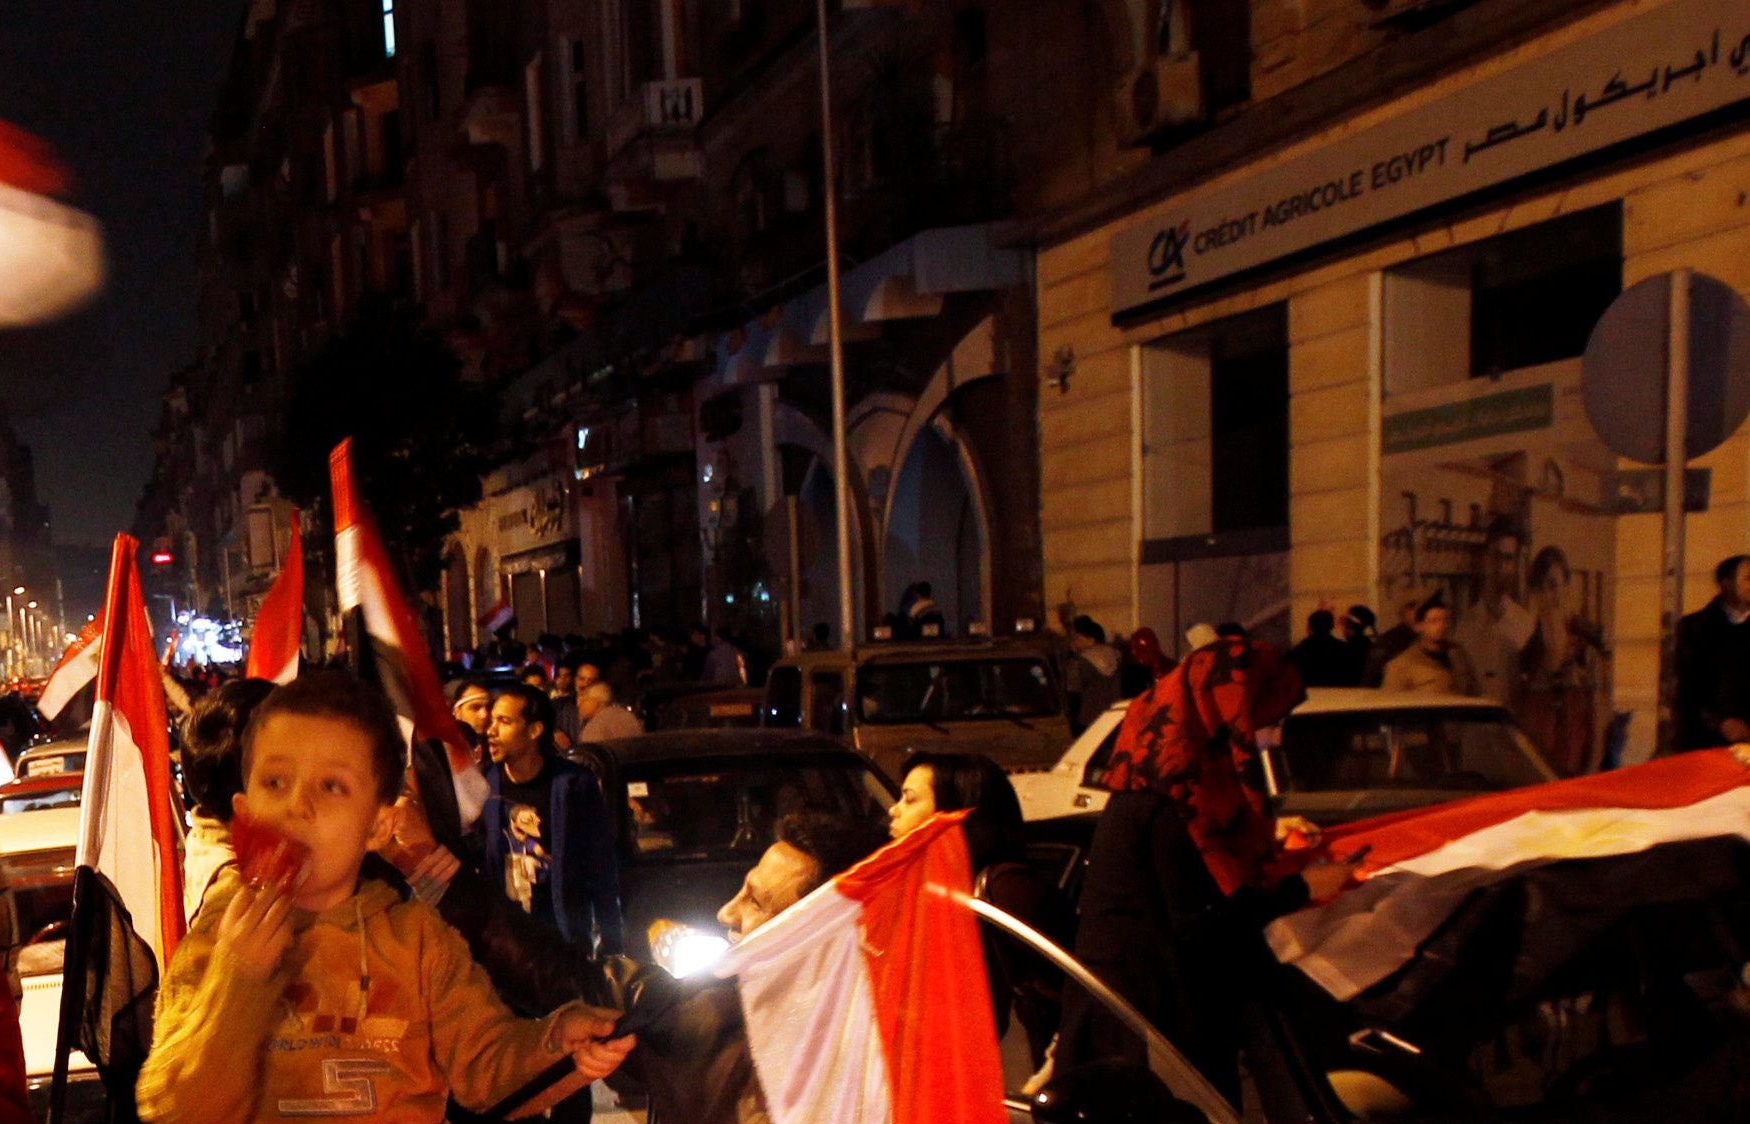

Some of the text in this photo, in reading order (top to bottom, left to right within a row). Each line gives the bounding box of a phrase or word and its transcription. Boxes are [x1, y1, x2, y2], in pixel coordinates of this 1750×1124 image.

[1462, 106, 1548, 163] مصر
[1193, 212, 1259, 255] CRÉDIT
[1261, 170, 1365, 231] AGRICOLE
[1371, 138, 1449, 191] EGYPT
